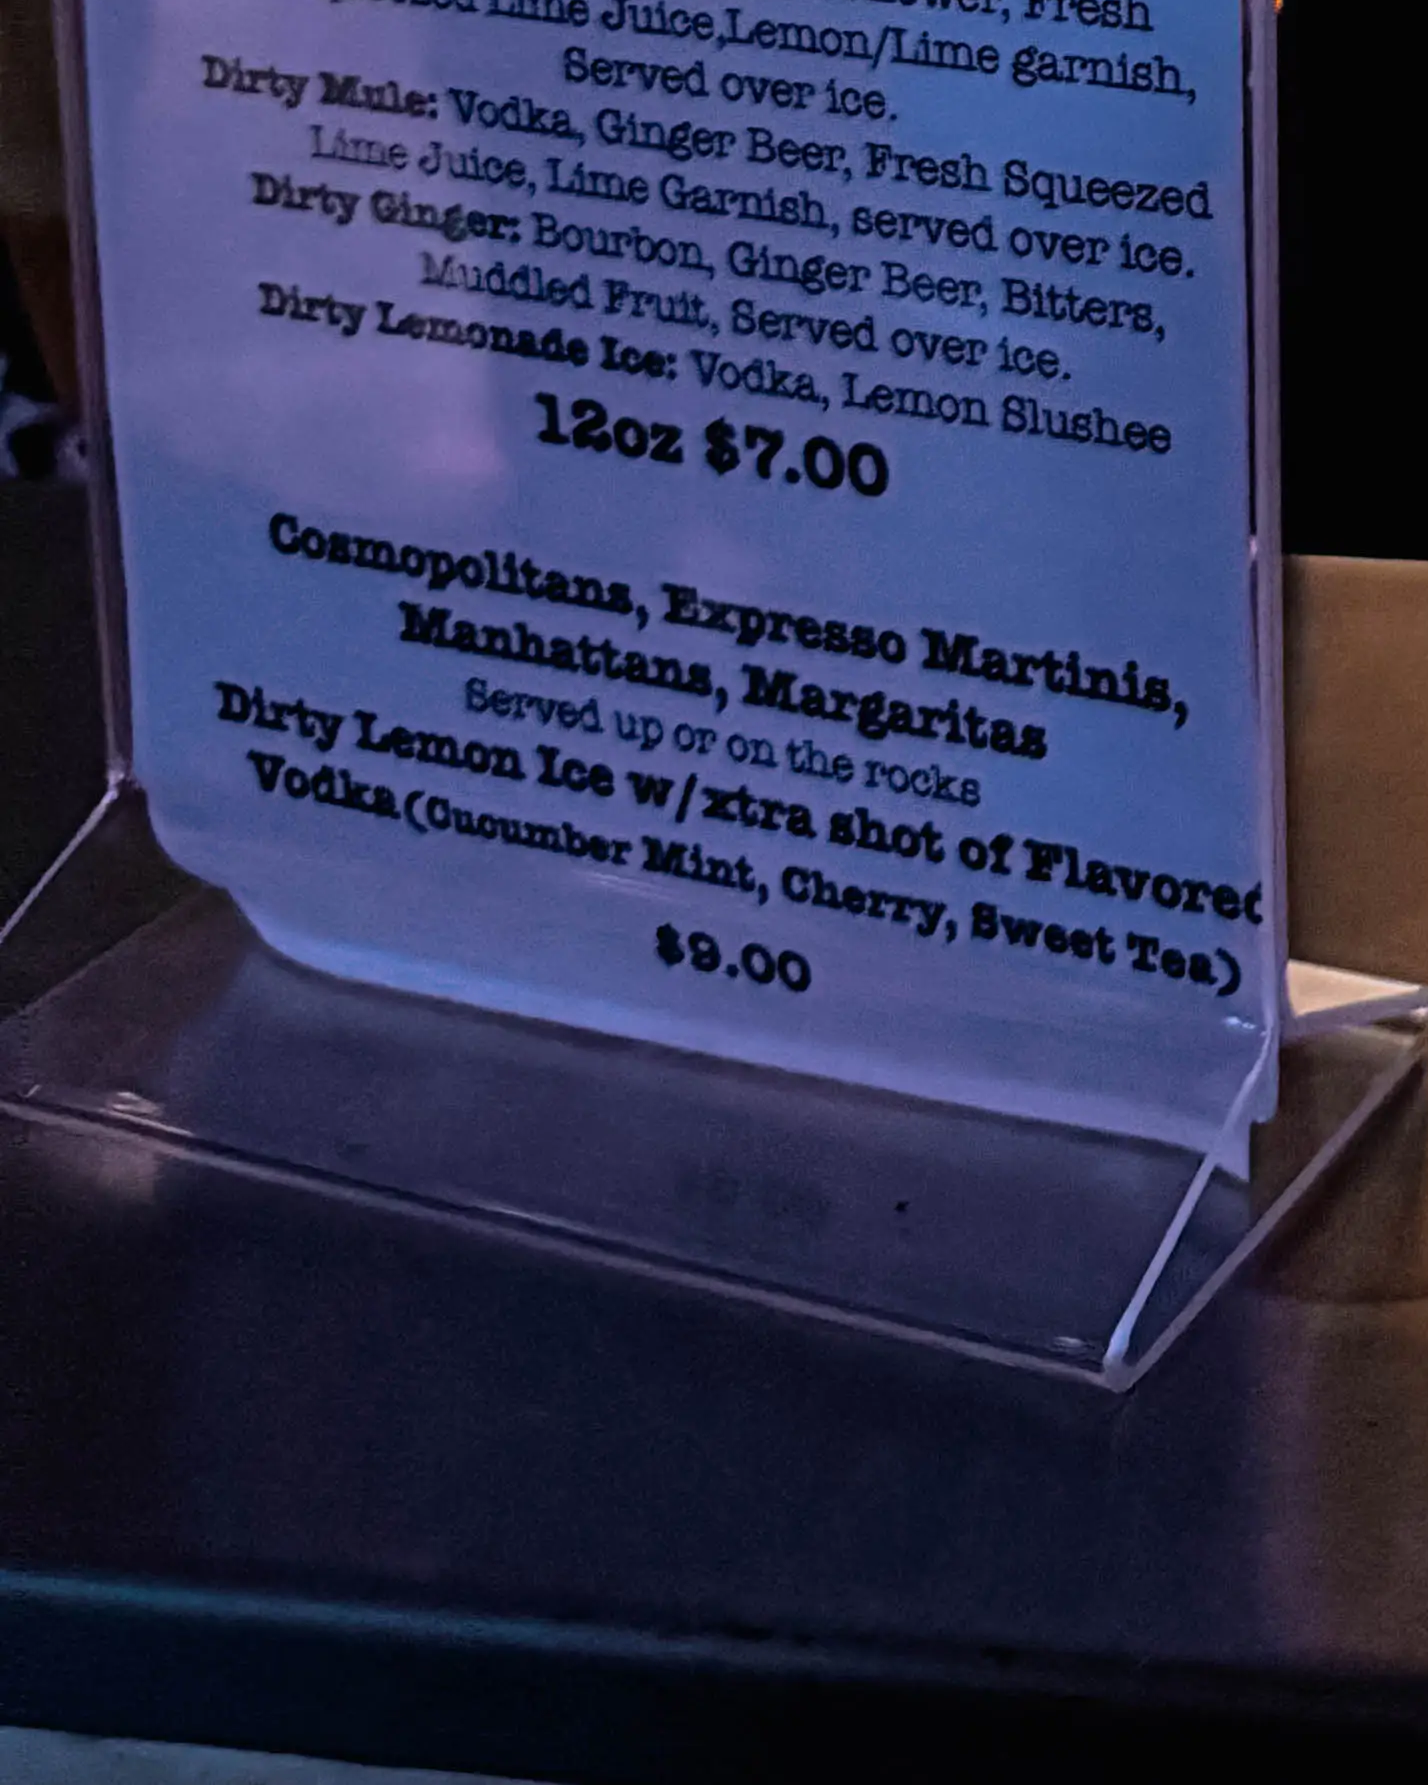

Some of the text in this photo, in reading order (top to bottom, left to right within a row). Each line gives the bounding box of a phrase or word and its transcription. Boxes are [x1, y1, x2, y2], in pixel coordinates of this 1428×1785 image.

[200, 54, 310, 111] Dirty
[445, 87, 586, 148] Vodka,
[595, 107, 737, 162] Ginger
[746, 126, 853, 183] Beer,
[864, 141, 993, 192] Fresh
[1003, 158, 1214, 220] Squeezed
[562, 46, 898, 122] Served over ice.
[1011, 45, 1197, 106] garnish,
[250, 171, 1166, 344] Dirty Ginger: Bourbon, Ginger Beer, Bitters,
[310, 124, 1195, 279] Lime Juice, Lime Garnish, served over ice.
[257, 281, 1172, 455] Dirty Lemonade Ice: Vodka, Lemon Slushee
[420, 251, 1072, 381] Muddled Fruit, Served over ice.
[534, 391, 890, 498] 12oz $7.00
[268, 512, 1189, 731] Cosmopolitans, Expresso Martinis,
[397, 600, 1048, 761] Manhattans, Margaritas
[213, 680, 345, 753] Dirty
[352, 709, 527, 781] Lemon
[535, 744, 615, 798] Ice
[828, 807, 945, 865] shot
[958, 833, 1015, 876] of
[464, 677, 981, 808] Served up or on the rocks
[641, 835, 769, 907] Mint,
[780, 866, 957, 944] Cherry,
[970, 901, 1116, 966] Sweet
[1126, 931, 1242, 998] Tea)
[655, 922, 812, 994] $9.00
